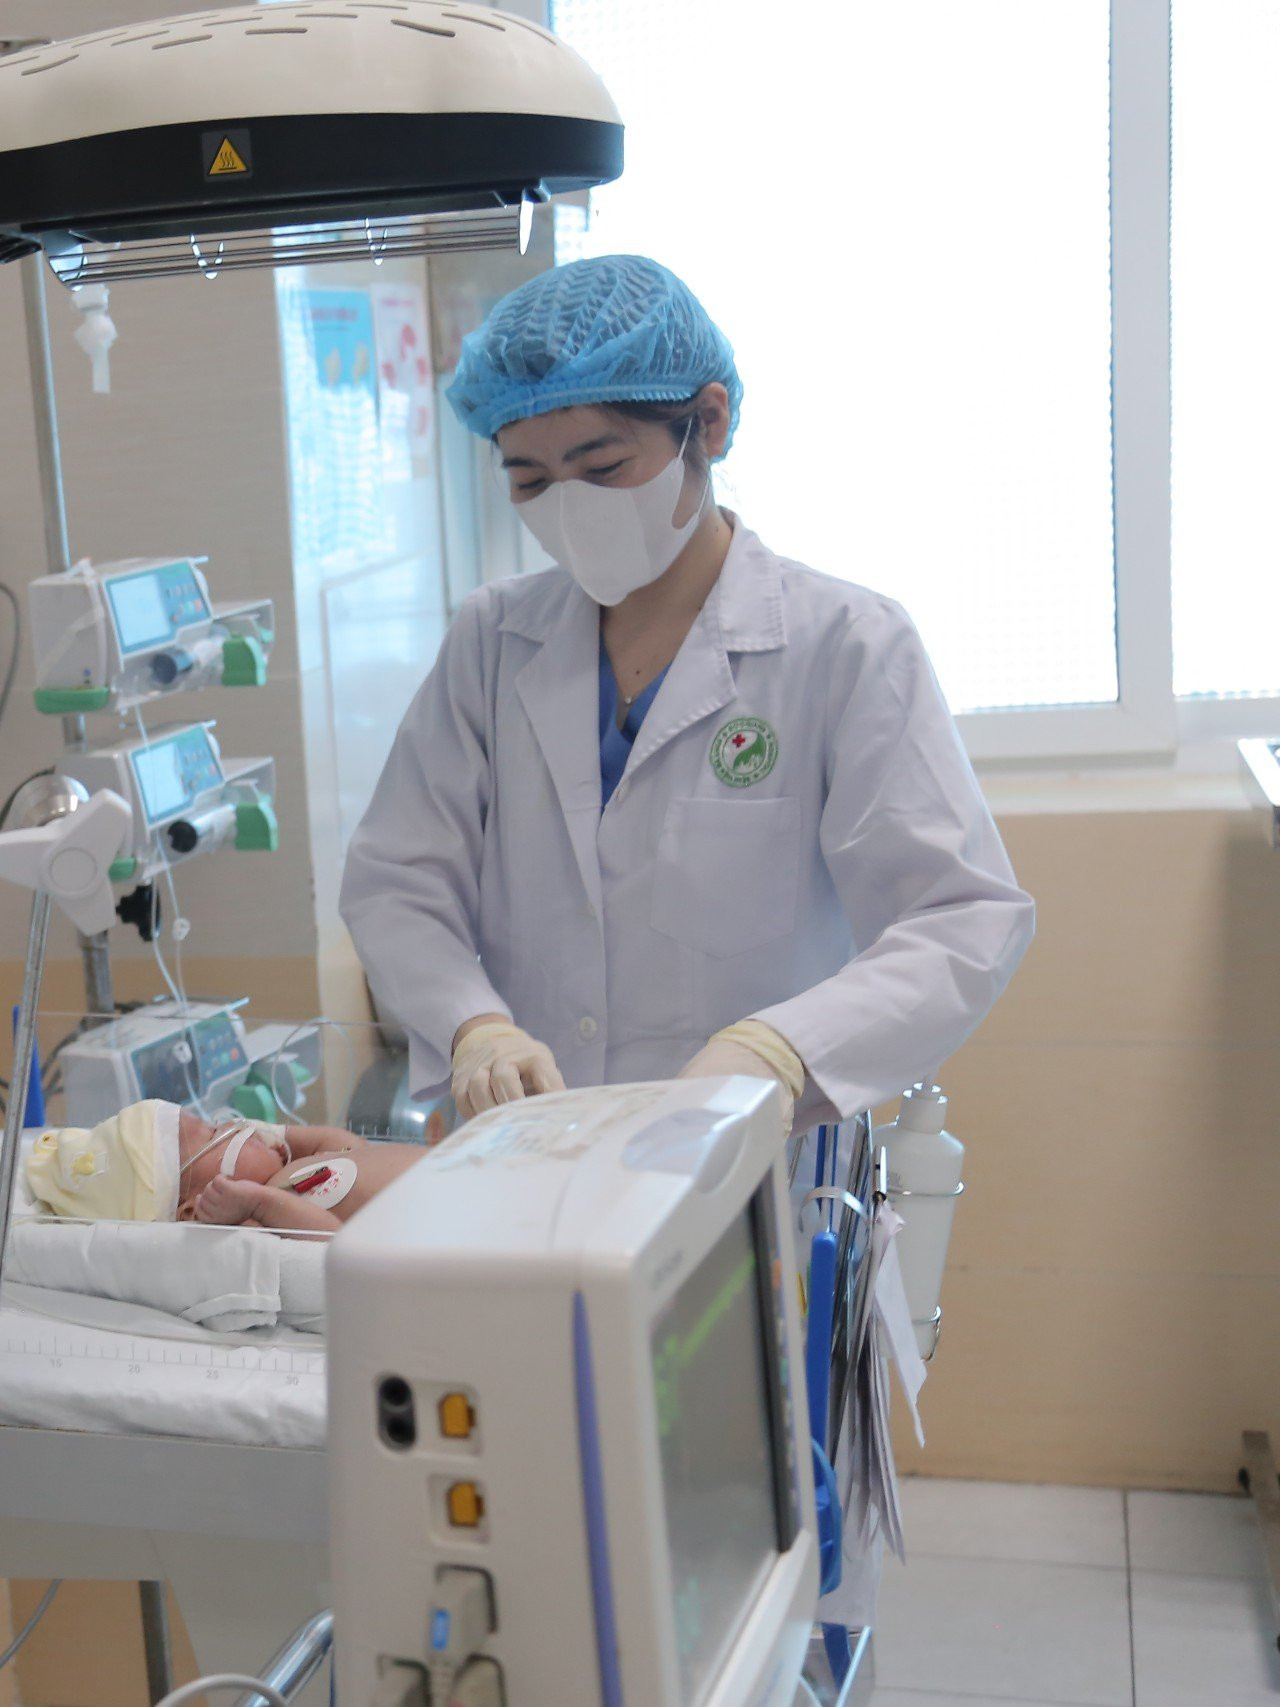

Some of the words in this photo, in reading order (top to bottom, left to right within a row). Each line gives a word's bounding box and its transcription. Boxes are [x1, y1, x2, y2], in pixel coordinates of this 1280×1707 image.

[49, 1358, 62, 1369] 15
[127, 1364, 141, 1375] 20
[206, 1369, 220, 1380] 25
[285, 1375, 299, 1386] 30
